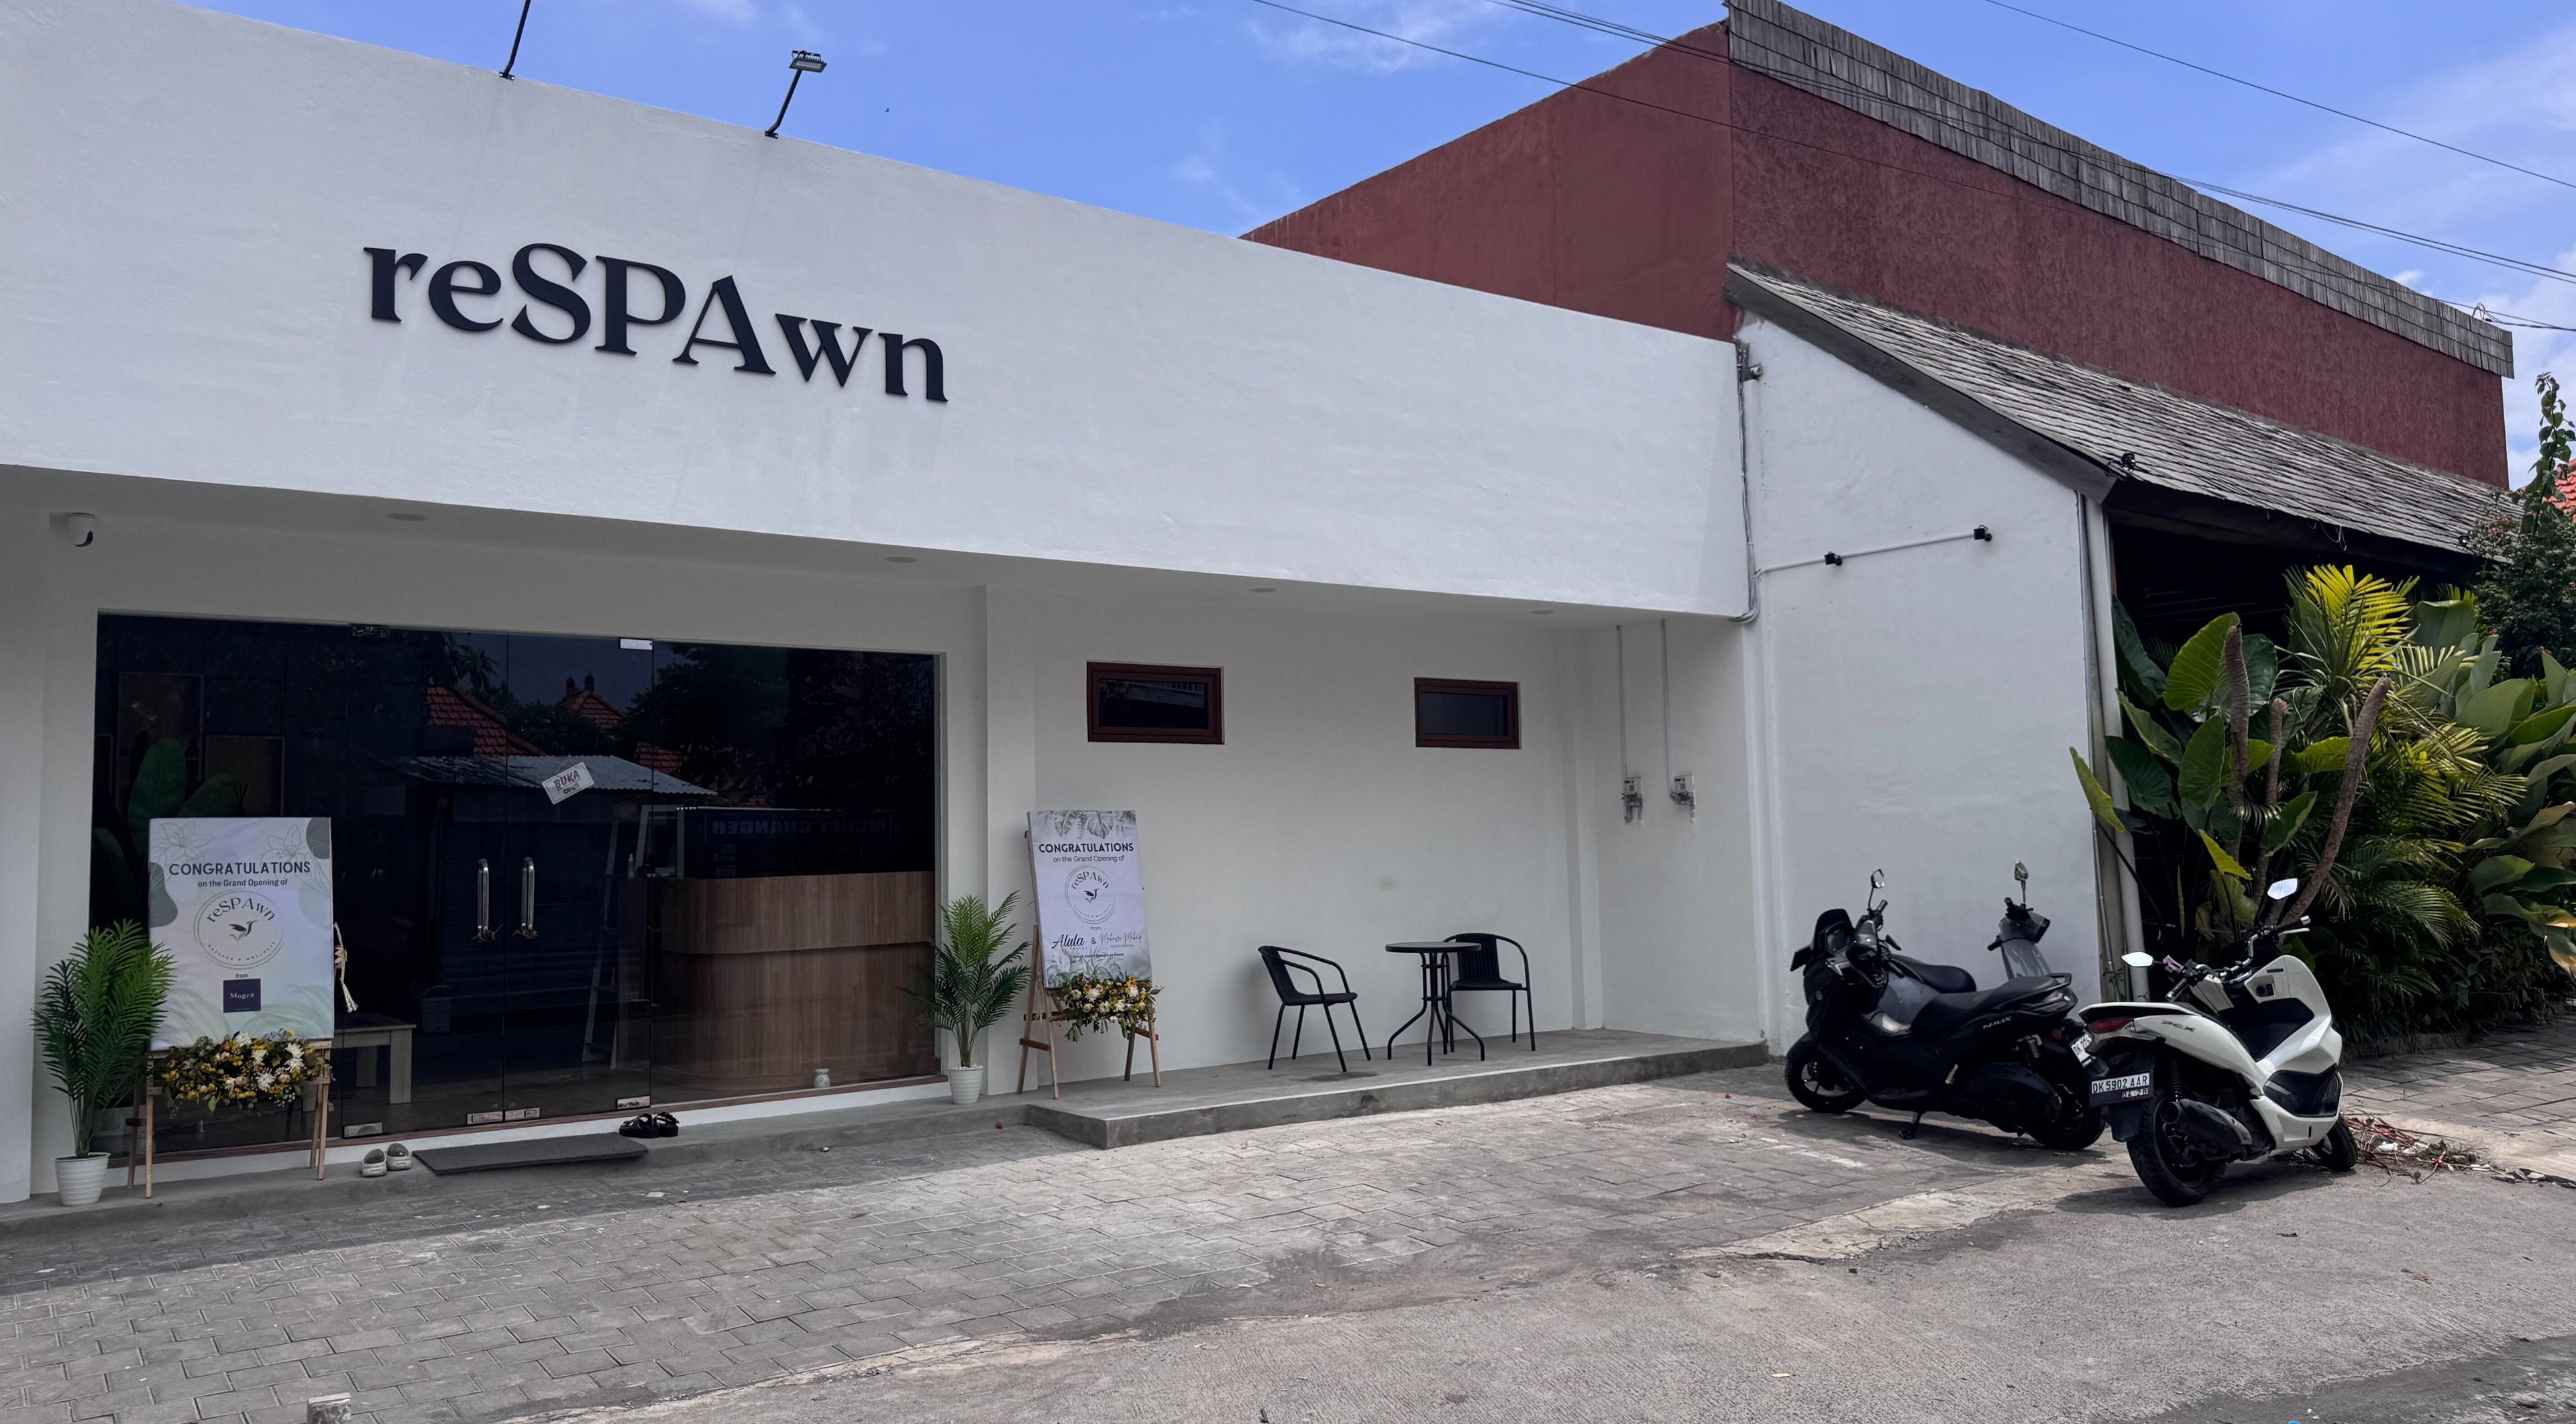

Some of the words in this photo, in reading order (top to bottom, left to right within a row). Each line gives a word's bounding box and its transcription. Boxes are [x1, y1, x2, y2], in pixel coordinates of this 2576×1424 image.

[363, 243, 948, 402] reSPAwn
[553, 770, 580, 789] BUKA
[1038, 842, 1134, 853] CONGRATULATIONS
[169, 861, 311, 875] CONGRATULATIONS
[248, 879, 279, 887] Opening
[1071, 871, 1110, 889] reSPAwn
[207, 897, 275, 922] reSPAwn
[1051, 934, 1085, 949] Alula
[2093, 1081, 2104, 1093] DK
[2106, 1078, 2128, 1091] 5902
[2131, 1075, 2147, 1087] AAR
